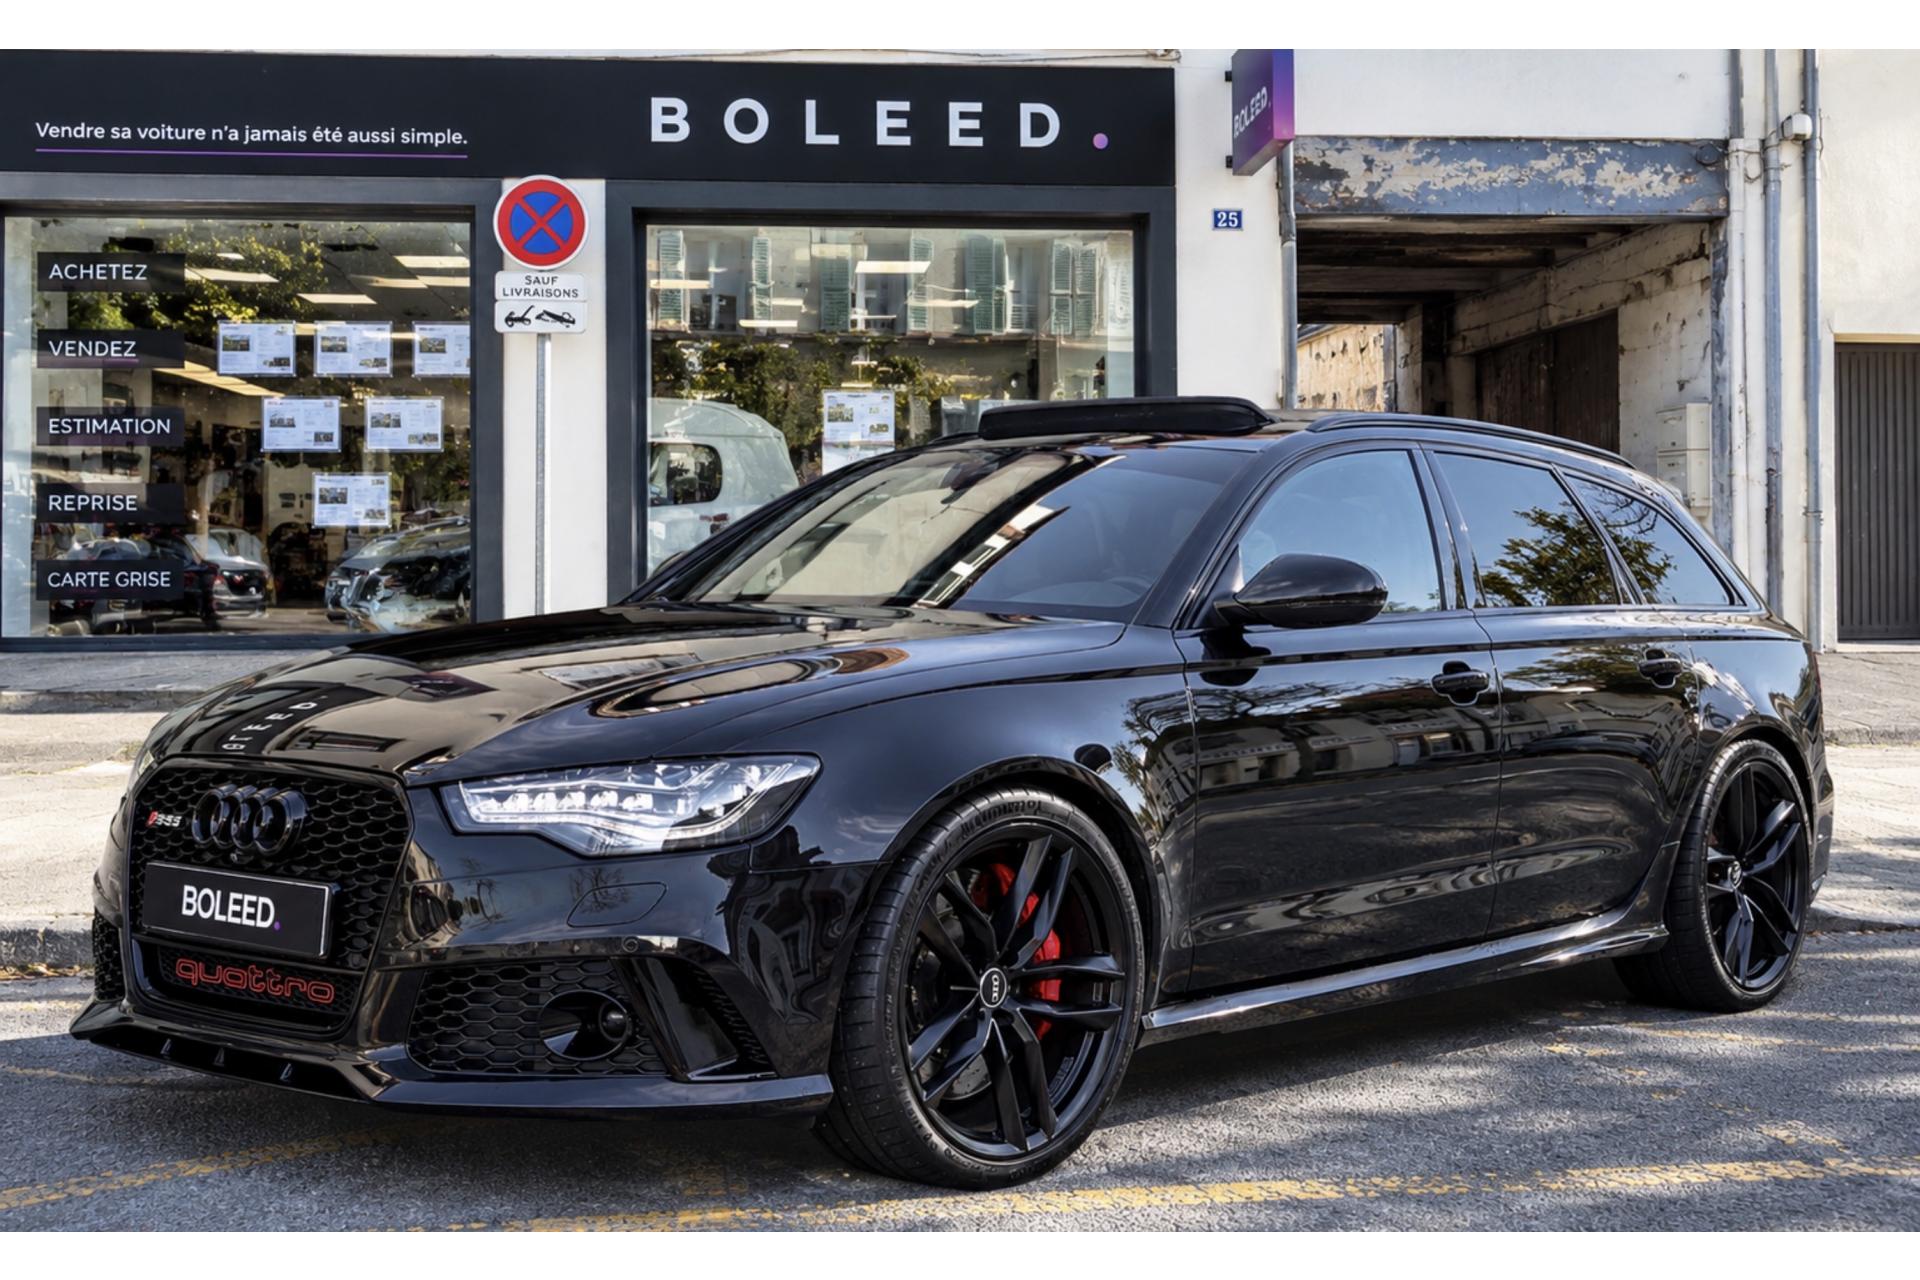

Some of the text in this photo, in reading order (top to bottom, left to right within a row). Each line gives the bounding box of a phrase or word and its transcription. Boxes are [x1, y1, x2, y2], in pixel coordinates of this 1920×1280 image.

[35, 122, 468, 146] Vendre sa voiture n'a jamais été aussi simple.
[1217, 211, 1239, 227] 25
[48, 263, 148, 281] ACHETEZ
[524, 275, 558, 286] SAUF
[502, 287, 579, 299] LIVRAISONS
[48, 340, 137, 357] VENDEZ
[48, 418, 171, 435] ESTIMATION
[48, 494, 138, 511] REPRISE
[47, 571, 171, 588] CARTE GRISE
[175, 957, 335, 1004] quattro
